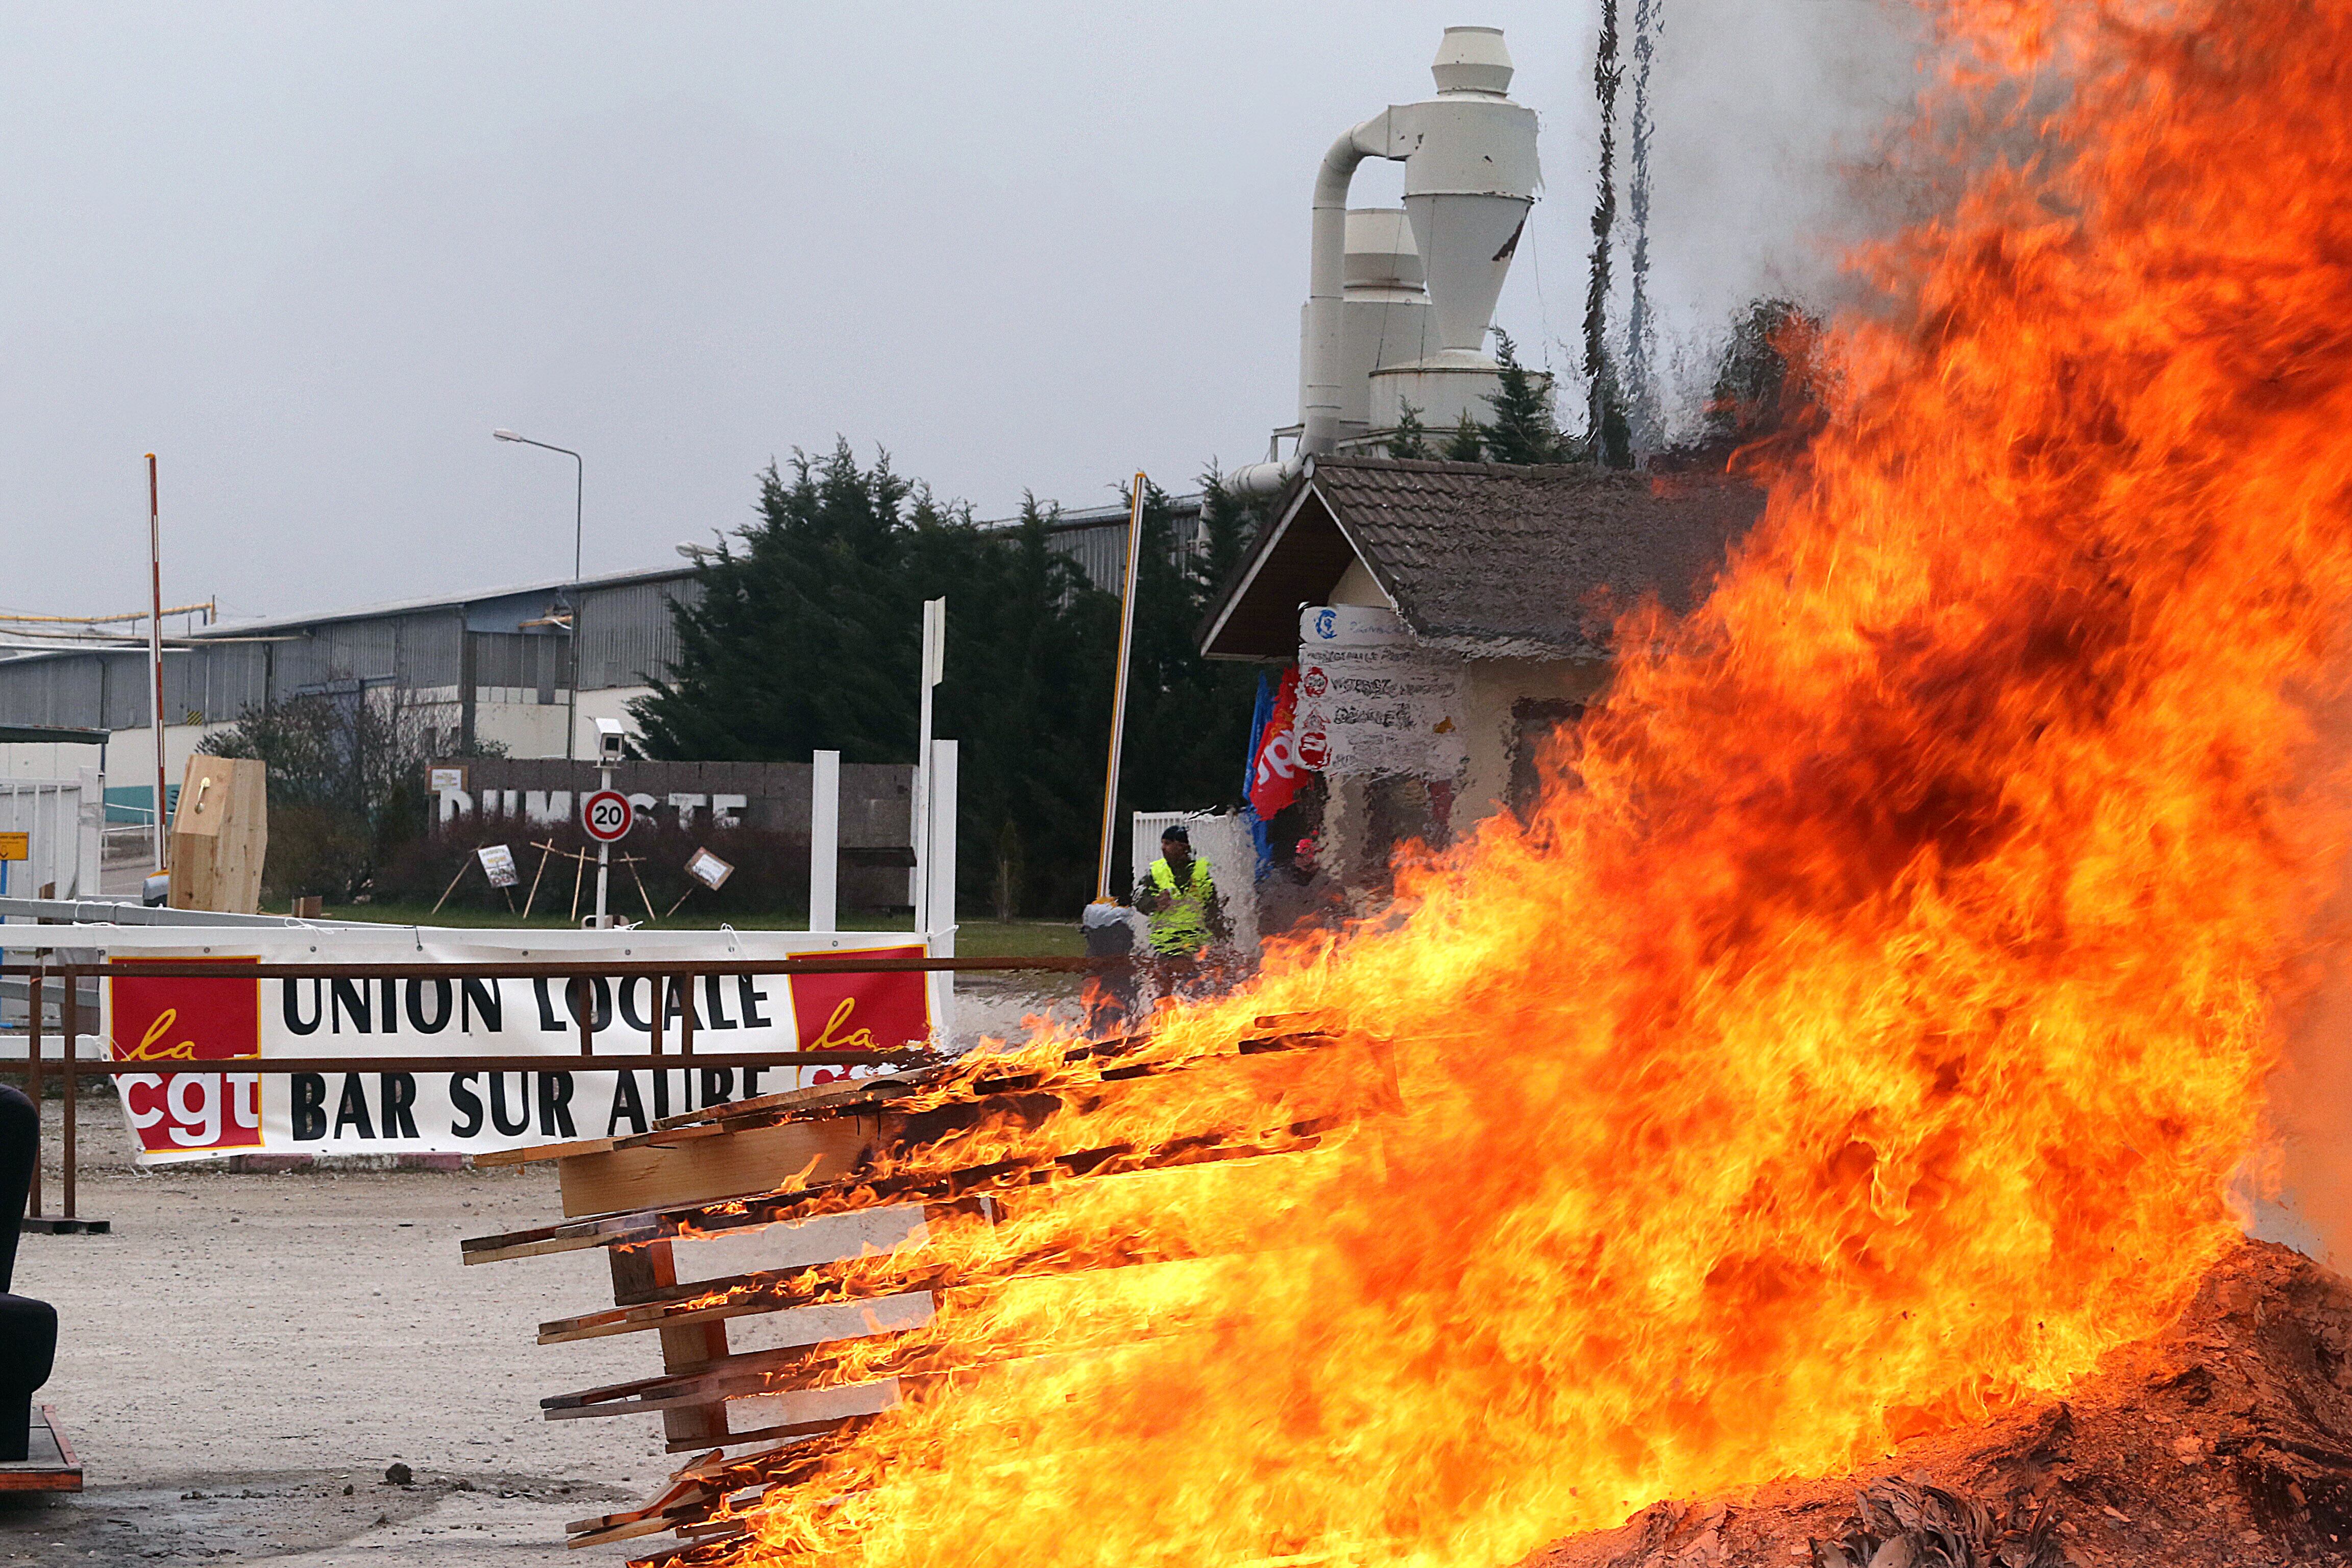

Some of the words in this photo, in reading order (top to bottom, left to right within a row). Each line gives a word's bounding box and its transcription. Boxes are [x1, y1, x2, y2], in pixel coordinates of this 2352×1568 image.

[439, 790, 747, 833] DUMSTE
[594, 805, 622, 825] 20
[283, 977, 503, 1036] UNION
[533, 974, 772, 1033] LOCALE
[805, 997, 879, 1051] la
[121, 1008, 196, 1062] la
[116, 1054, 258, 1146] cgt
[291, 1072, 421, 1141] BAR
[450, 1071, 578, 1138] SUR
